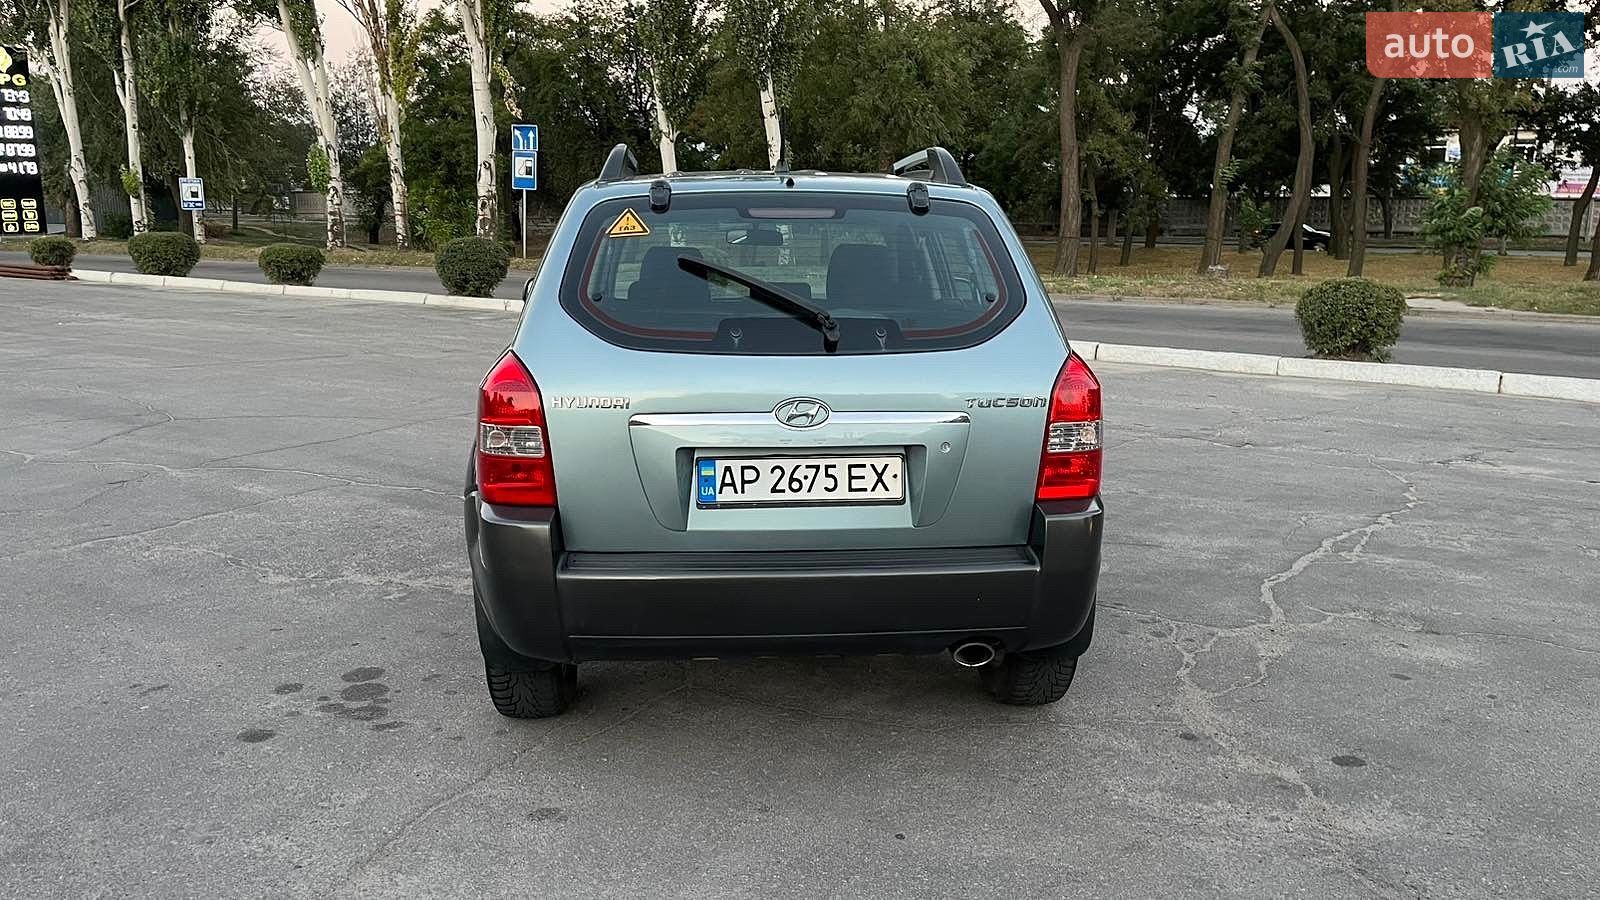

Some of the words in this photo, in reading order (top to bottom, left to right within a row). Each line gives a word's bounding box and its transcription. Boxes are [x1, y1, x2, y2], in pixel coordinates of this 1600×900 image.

[551, 396, 630, 410] HYUNDAI
[965, 397, 1047, 409] TUCSON
[718, 465, 760, 494] AP
[770, 464, 838, 494] 2675
[847, 463, 890, 493] EX
[701, 487, 715, 496] UA
